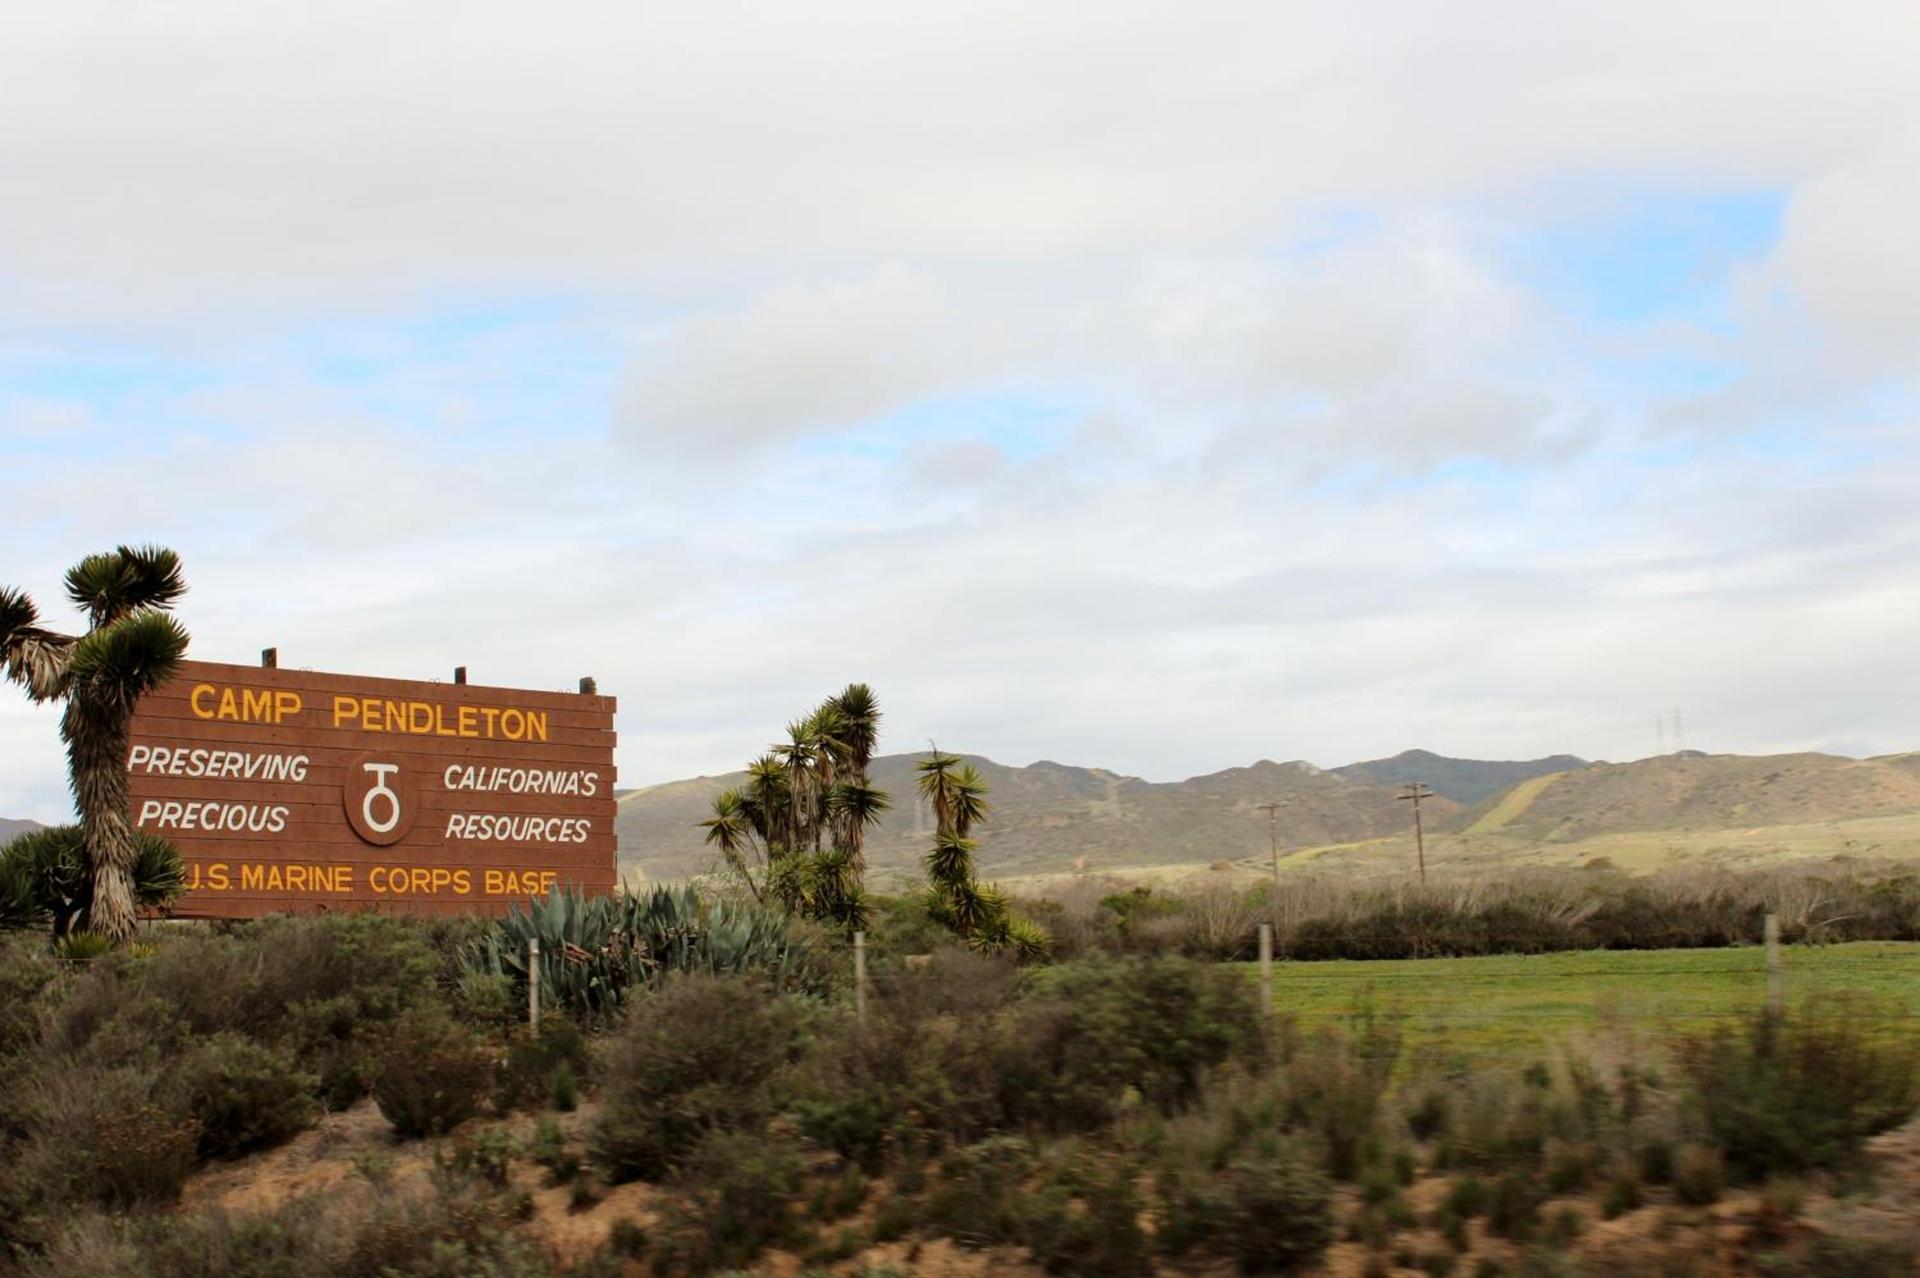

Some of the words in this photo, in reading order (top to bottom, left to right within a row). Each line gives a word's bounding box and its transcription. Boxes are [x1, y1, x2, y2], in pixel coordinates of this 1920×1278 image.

[191, 684, 302, 723] CAMP
[333, 695, 548, 741] PENDLETON
[127, 745, 309, 782] PRESERVING
[444, 764, 598, 796] CALIFORNIA'S
[137, 800, 289, 832] PRECIOUS
[444, 814, 591, 843] RESOURCES
[241, 864, 354, 892] MARINE
[369, 867, 472, 894] CORPS
[485, 870, 557, 895] BASE
